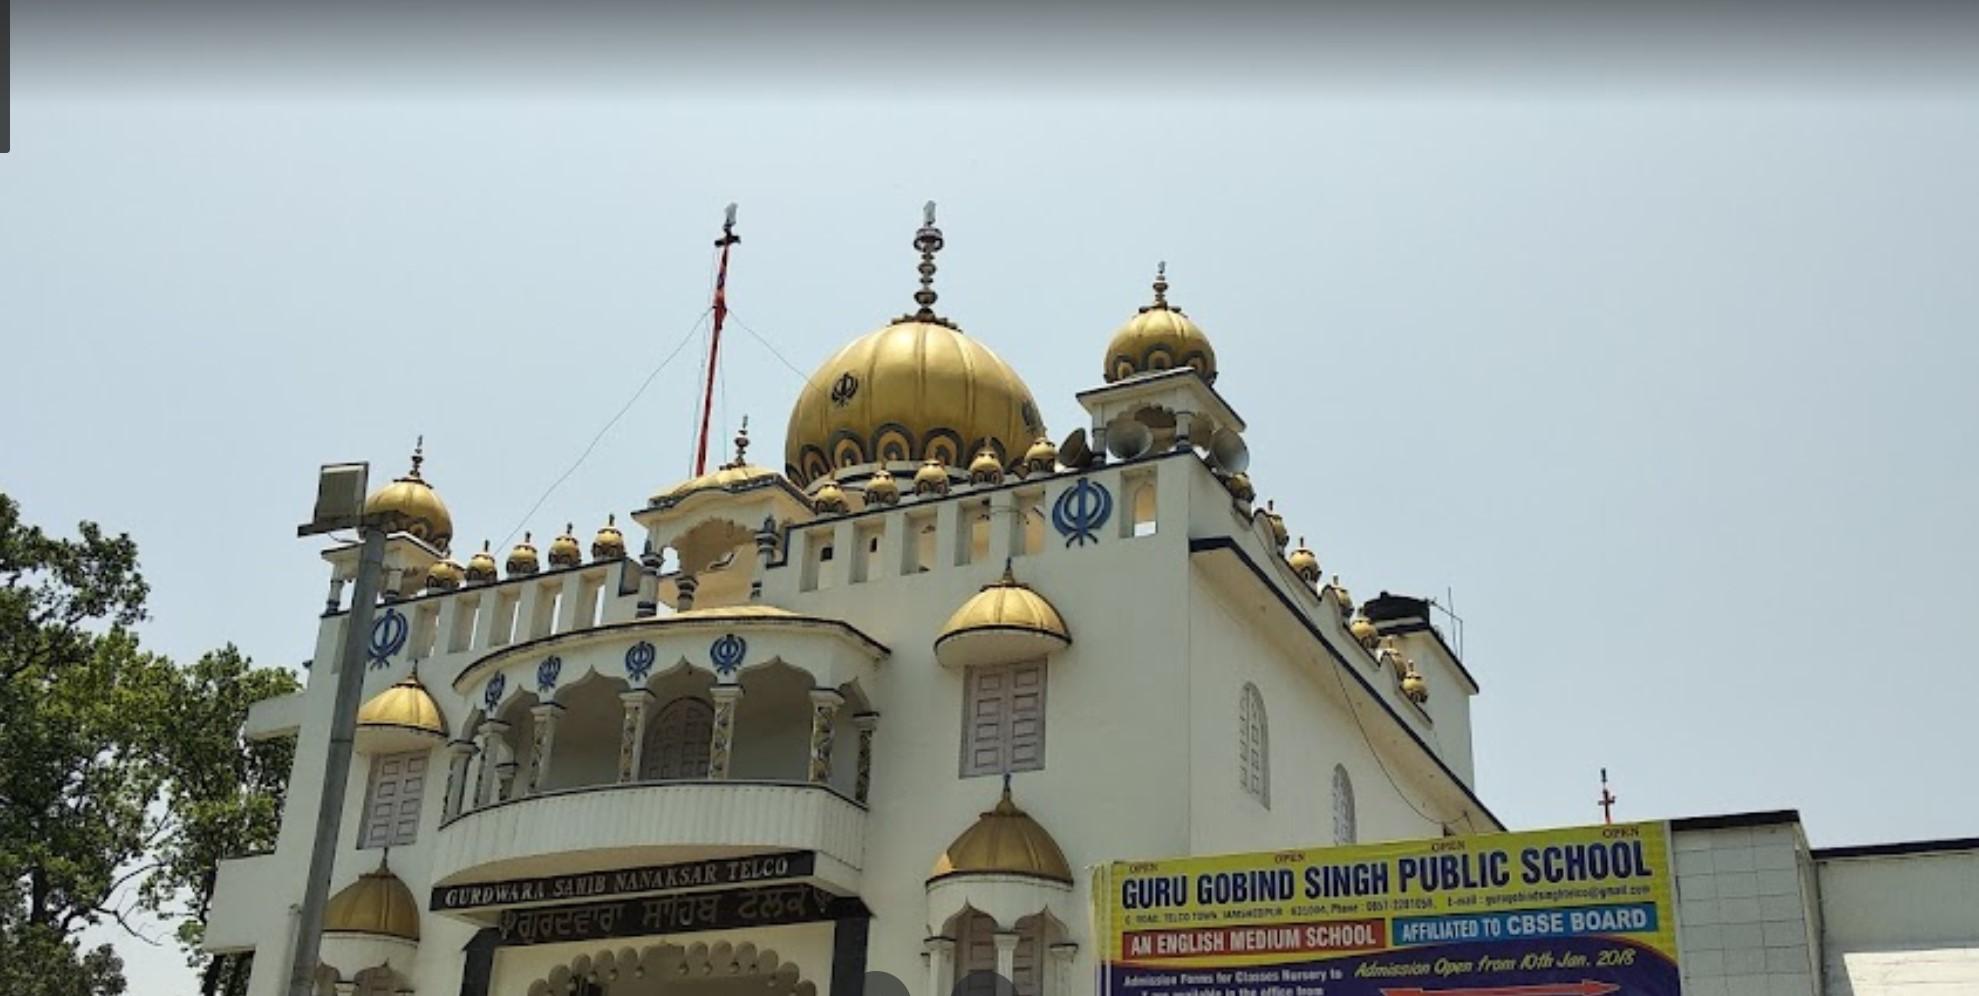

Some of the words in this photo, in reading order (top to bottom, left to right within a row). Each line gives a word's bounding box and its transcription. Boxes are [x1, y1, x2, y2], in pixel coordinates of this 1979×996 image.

[1431, 840, 1466, 852] OPEN
[1602, 826, 1640, 839] OPEN
[1274, 853, 1305, 865] OPEN
[444, 881, 545, 907] GURDWARA
[551, 875, 607, 898] SAHIB
[613, 864, 718, 891] NANAKSAR
[728, 857, 789, 881] TELCO
[1121, 875, 1188, 910] GURU
[1197, 868, 1295, 905] GOBIND
[1304, 861, 1389, 899] SINGH
[1398, 849, 1510, 893] PUBLIC
[1520, 840, 1653, 884] SCHOOL
[1131, 935, 1152, 956] AN
[1157, 930, 1224, 954] ENGLISH
[1230, 927, 1299, 951] MEDIUM
[1306, 923, 1376, 948] SCHOOL
[1402, 920, 1477, 943] AFFILIATED
[1483, 918, 1502, 937] TO
[1506, 912, 1564, 936] CBSE
[1571, 908, 1647, 932] BOARD
[1123, 975, 1177, 987] Admission
[1215, 971, 1233, 985] for
[1234, 969, 1280, 984] Classes
[1281, 967, 1327, 983] Nursery
[1330, 967, 1343, 980] to
[1355, 960, 1430, 977] Admission
[1434, 957, 1472, 978] Open
[1478, 954, 1515, 973] from
[1520, 953, 1552, 970] 10th
[1557, 950, 1591, 969] Jan.
